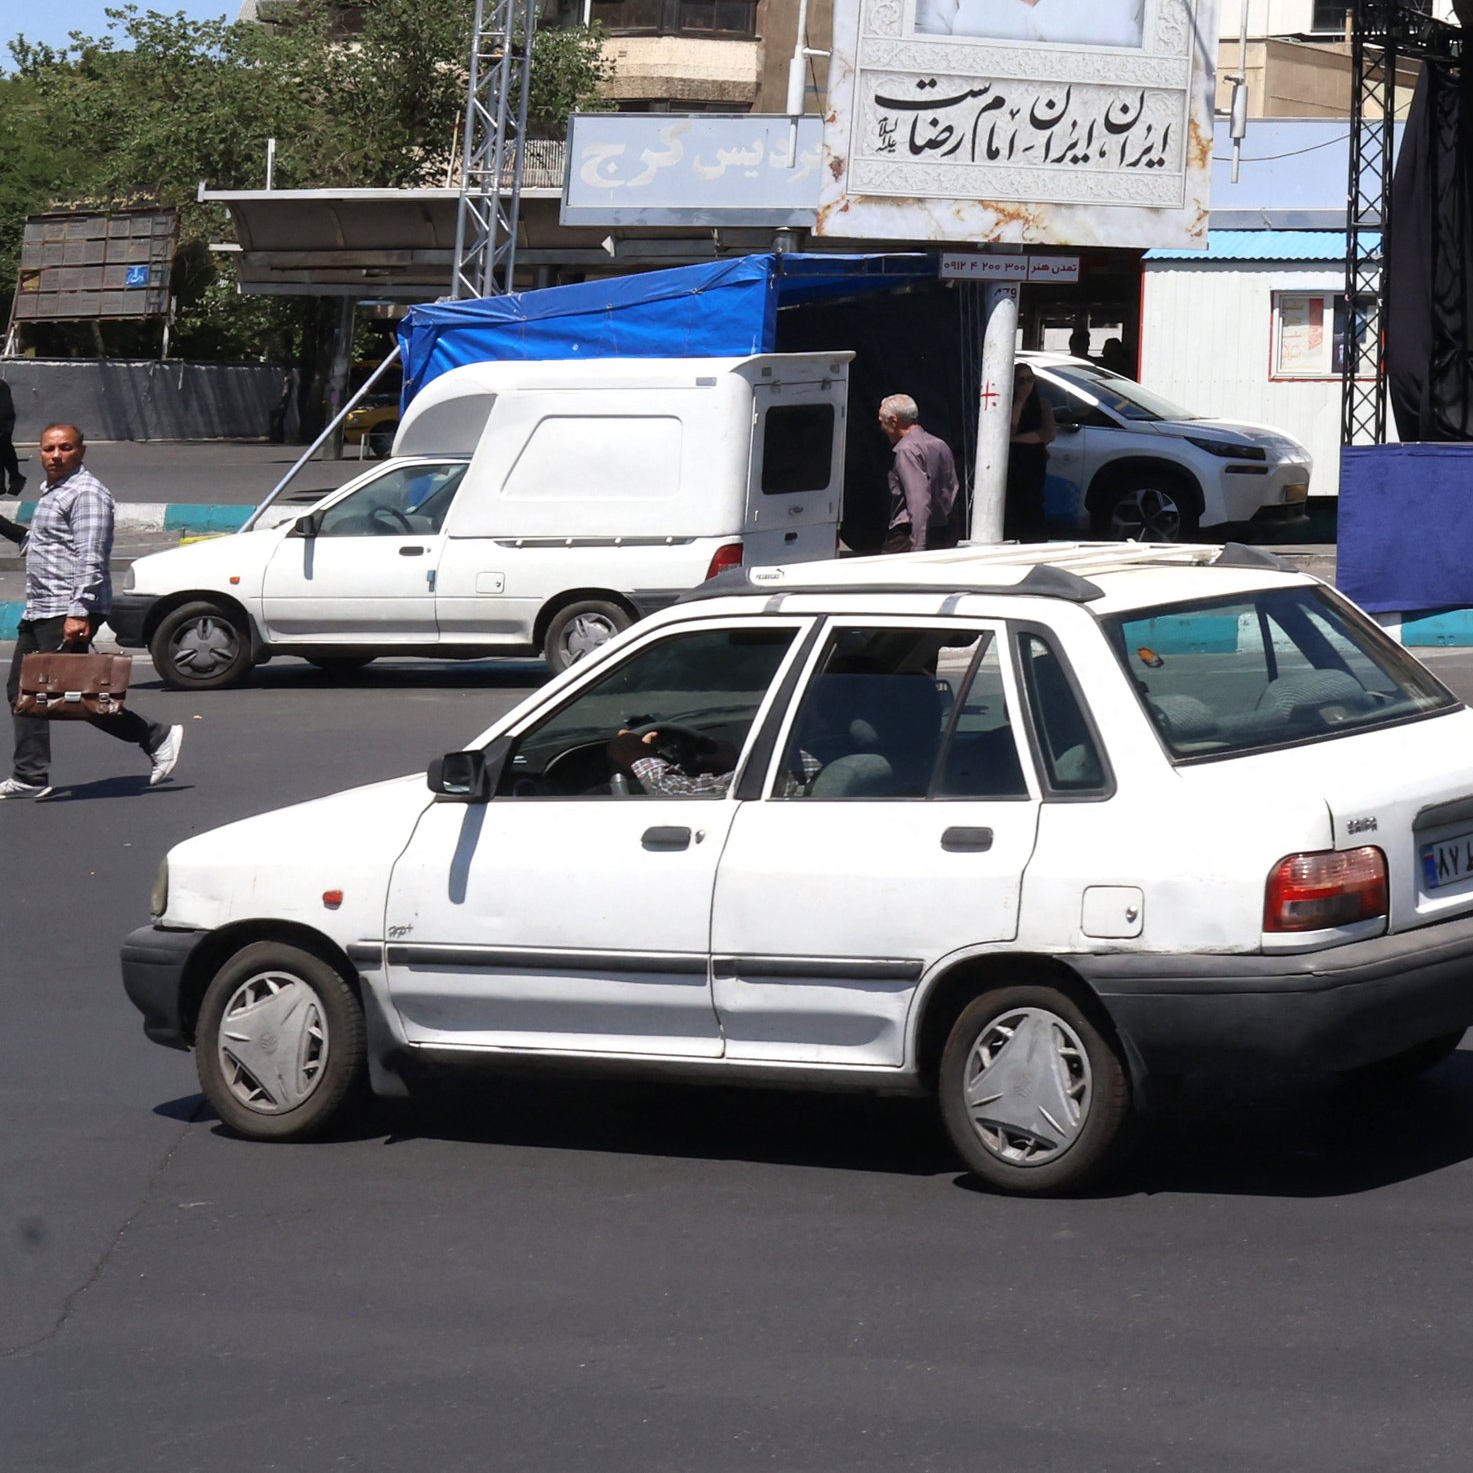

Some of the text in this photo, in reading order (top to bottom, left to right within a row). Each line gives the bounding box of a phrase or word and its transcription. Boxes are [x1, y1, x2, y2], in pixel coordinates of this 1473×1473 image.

[580, 121, 692, 188] کرج
[1031, 262, 1050, 274] هنر
[1051, 263, 1077, 274] تمدن
